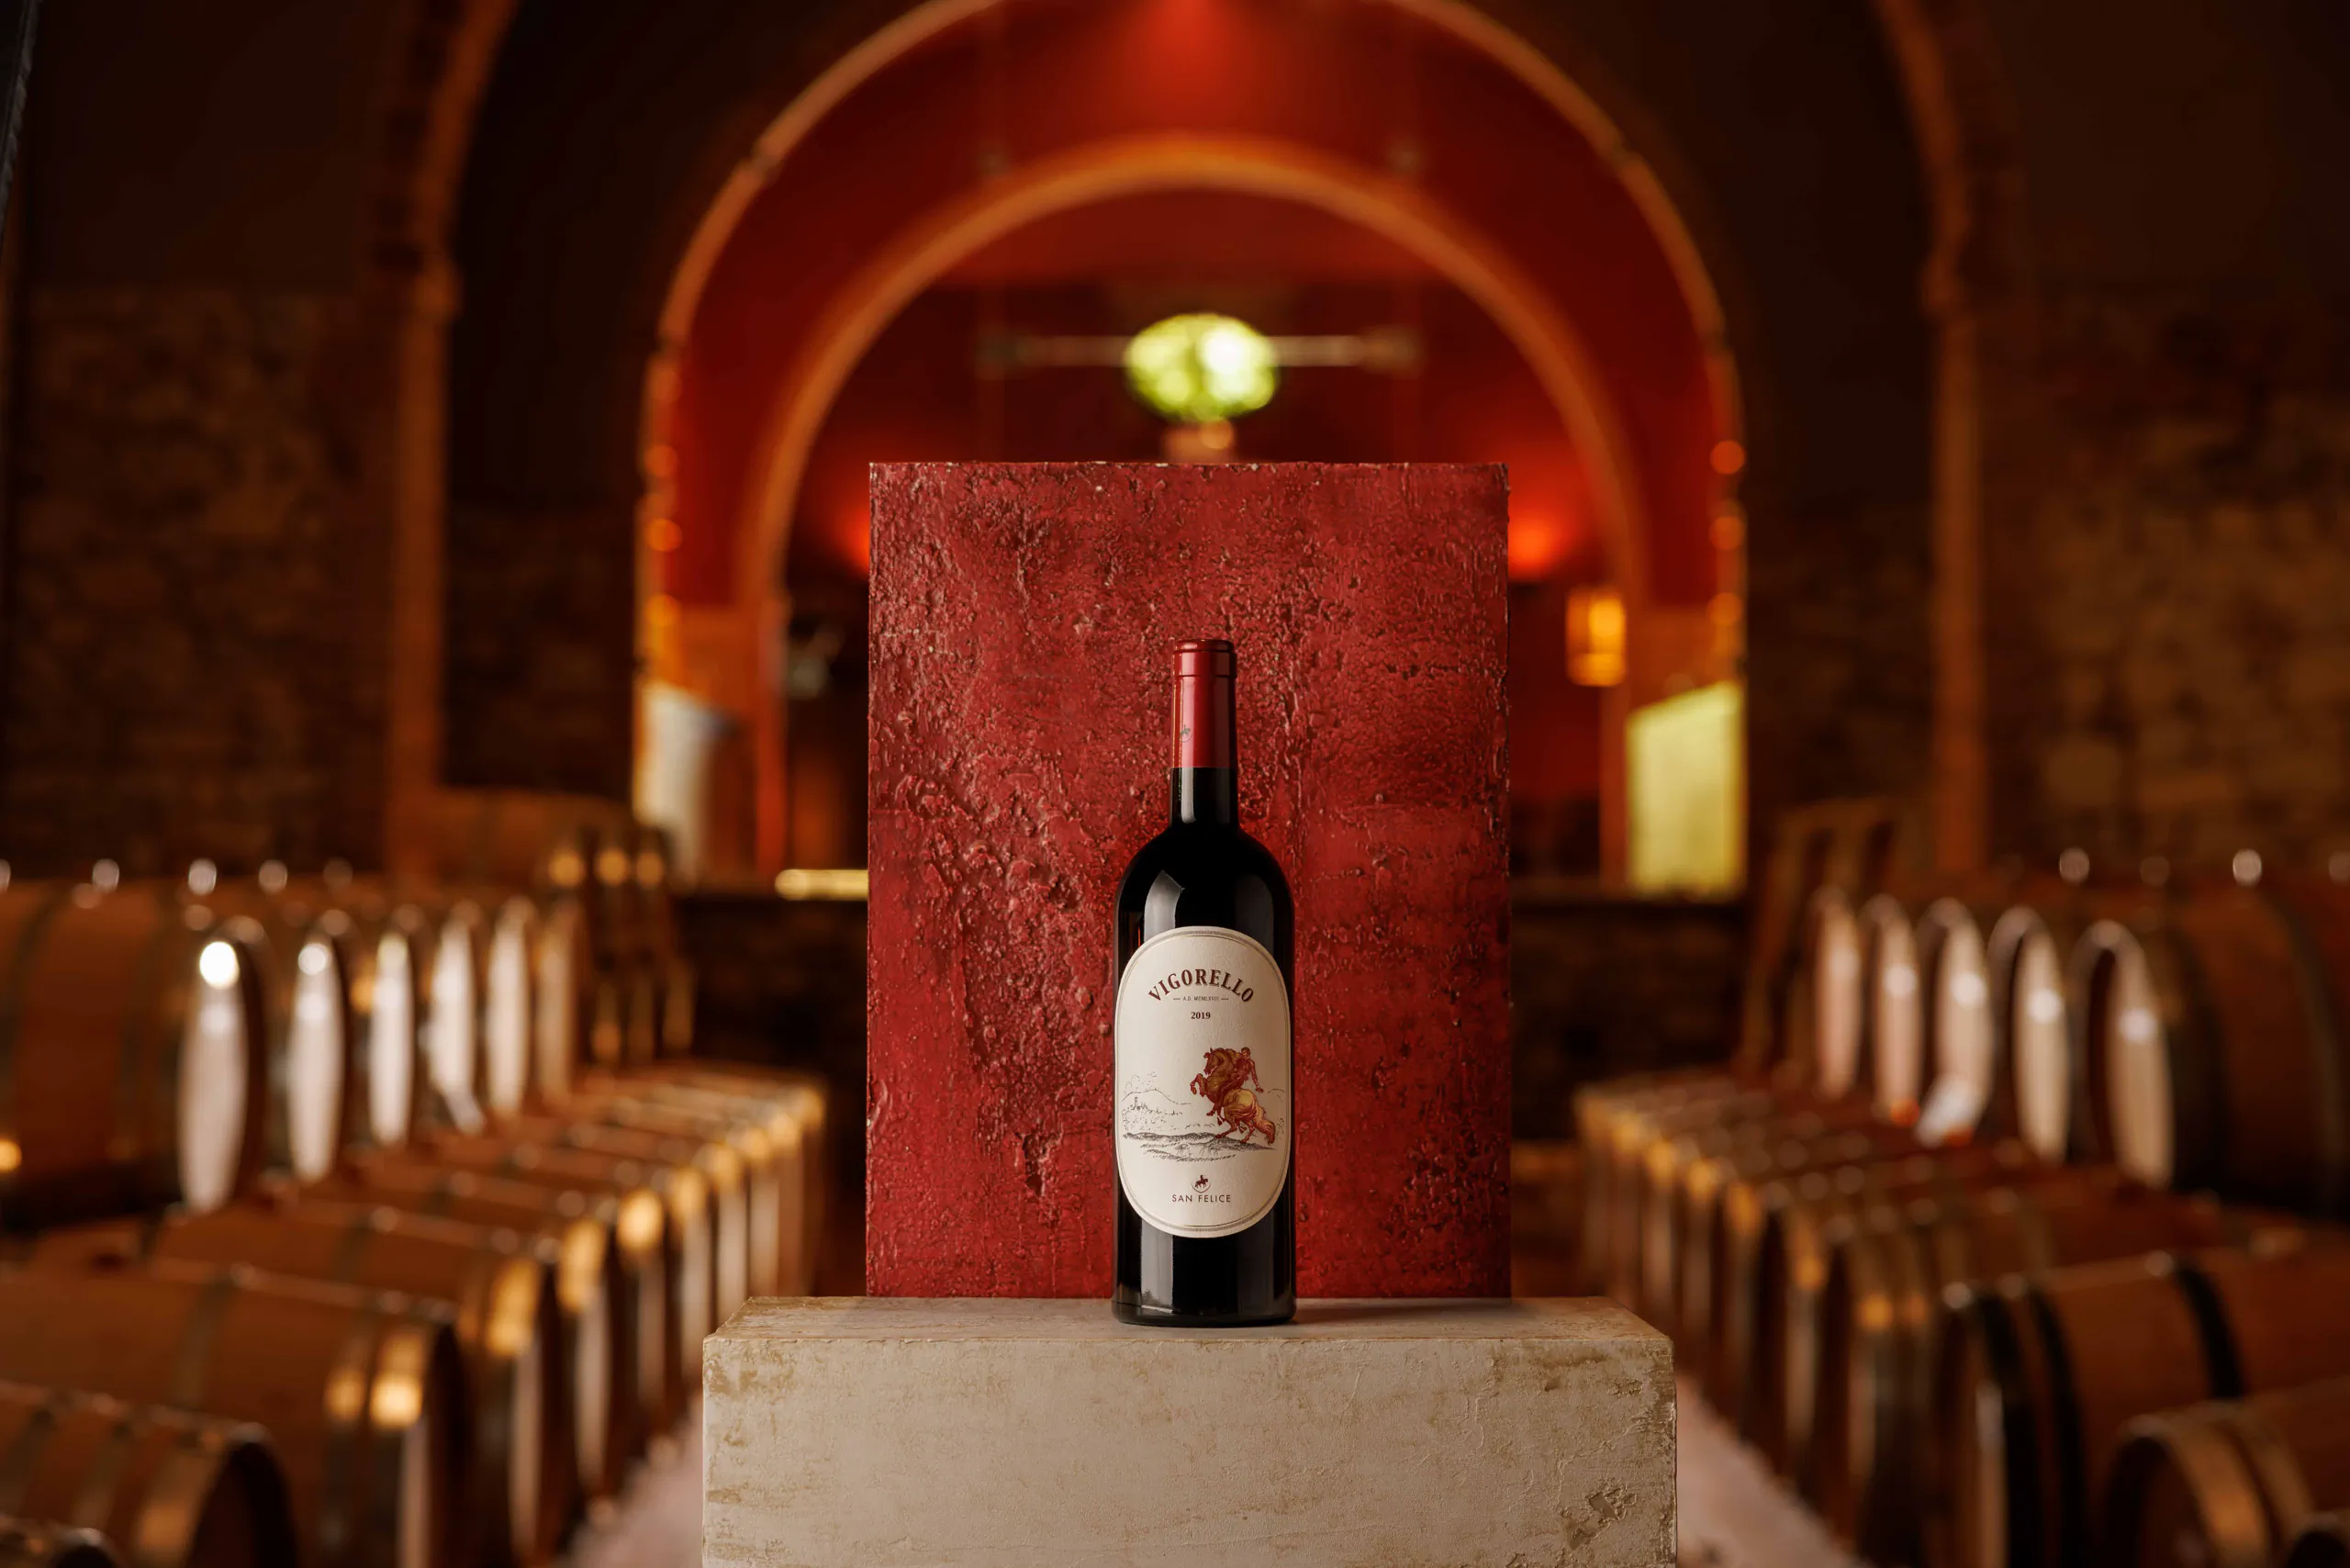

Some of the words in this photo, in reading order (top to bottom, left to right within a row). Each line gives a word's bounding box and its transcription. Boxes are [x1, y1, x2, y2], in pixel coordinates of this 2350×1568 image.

[1148, 969, 1254, 1002] VIGORELLO
[1191, 1012, 1211, 1020] 2019
[1171, 1194, 1192, 1203] SAN
[1198, 1194, 1231, 1203] FELICE
